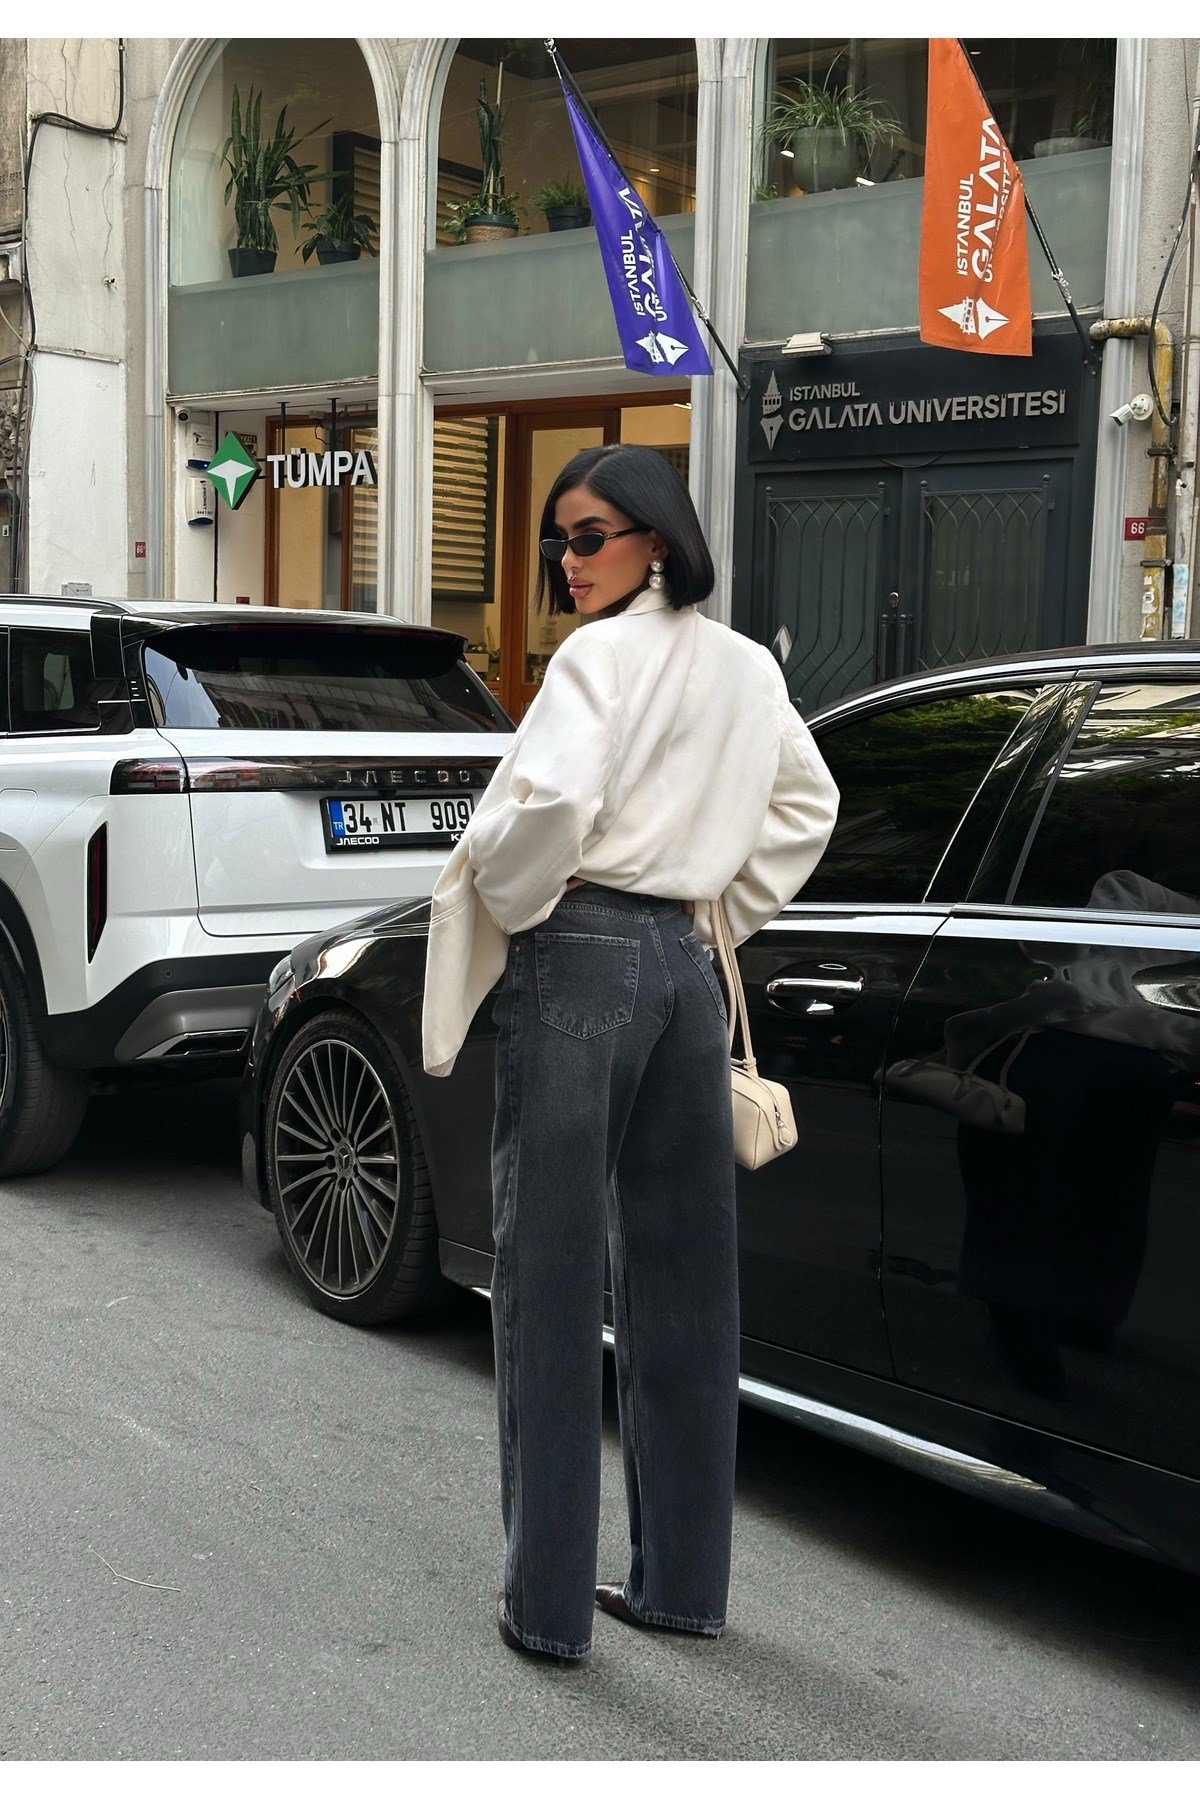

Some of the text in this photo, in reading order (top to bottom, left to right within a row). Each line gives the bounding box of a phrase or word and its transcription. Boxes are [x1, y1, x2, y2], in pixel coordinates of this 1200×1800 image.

[972, 118, 1001, 282] GALATA
[788, 402, 883, 431] GALATA
[266, 447, 376, 489] TÜMPA
[1131, 522, 1145, 534] 66
[338, 770, 471, 784] JAECOO
[333, 821, 344, 831] TR
[343, 800, 471, 833] 34 NT 909
[336, 836, 380, 846] JAECOO
